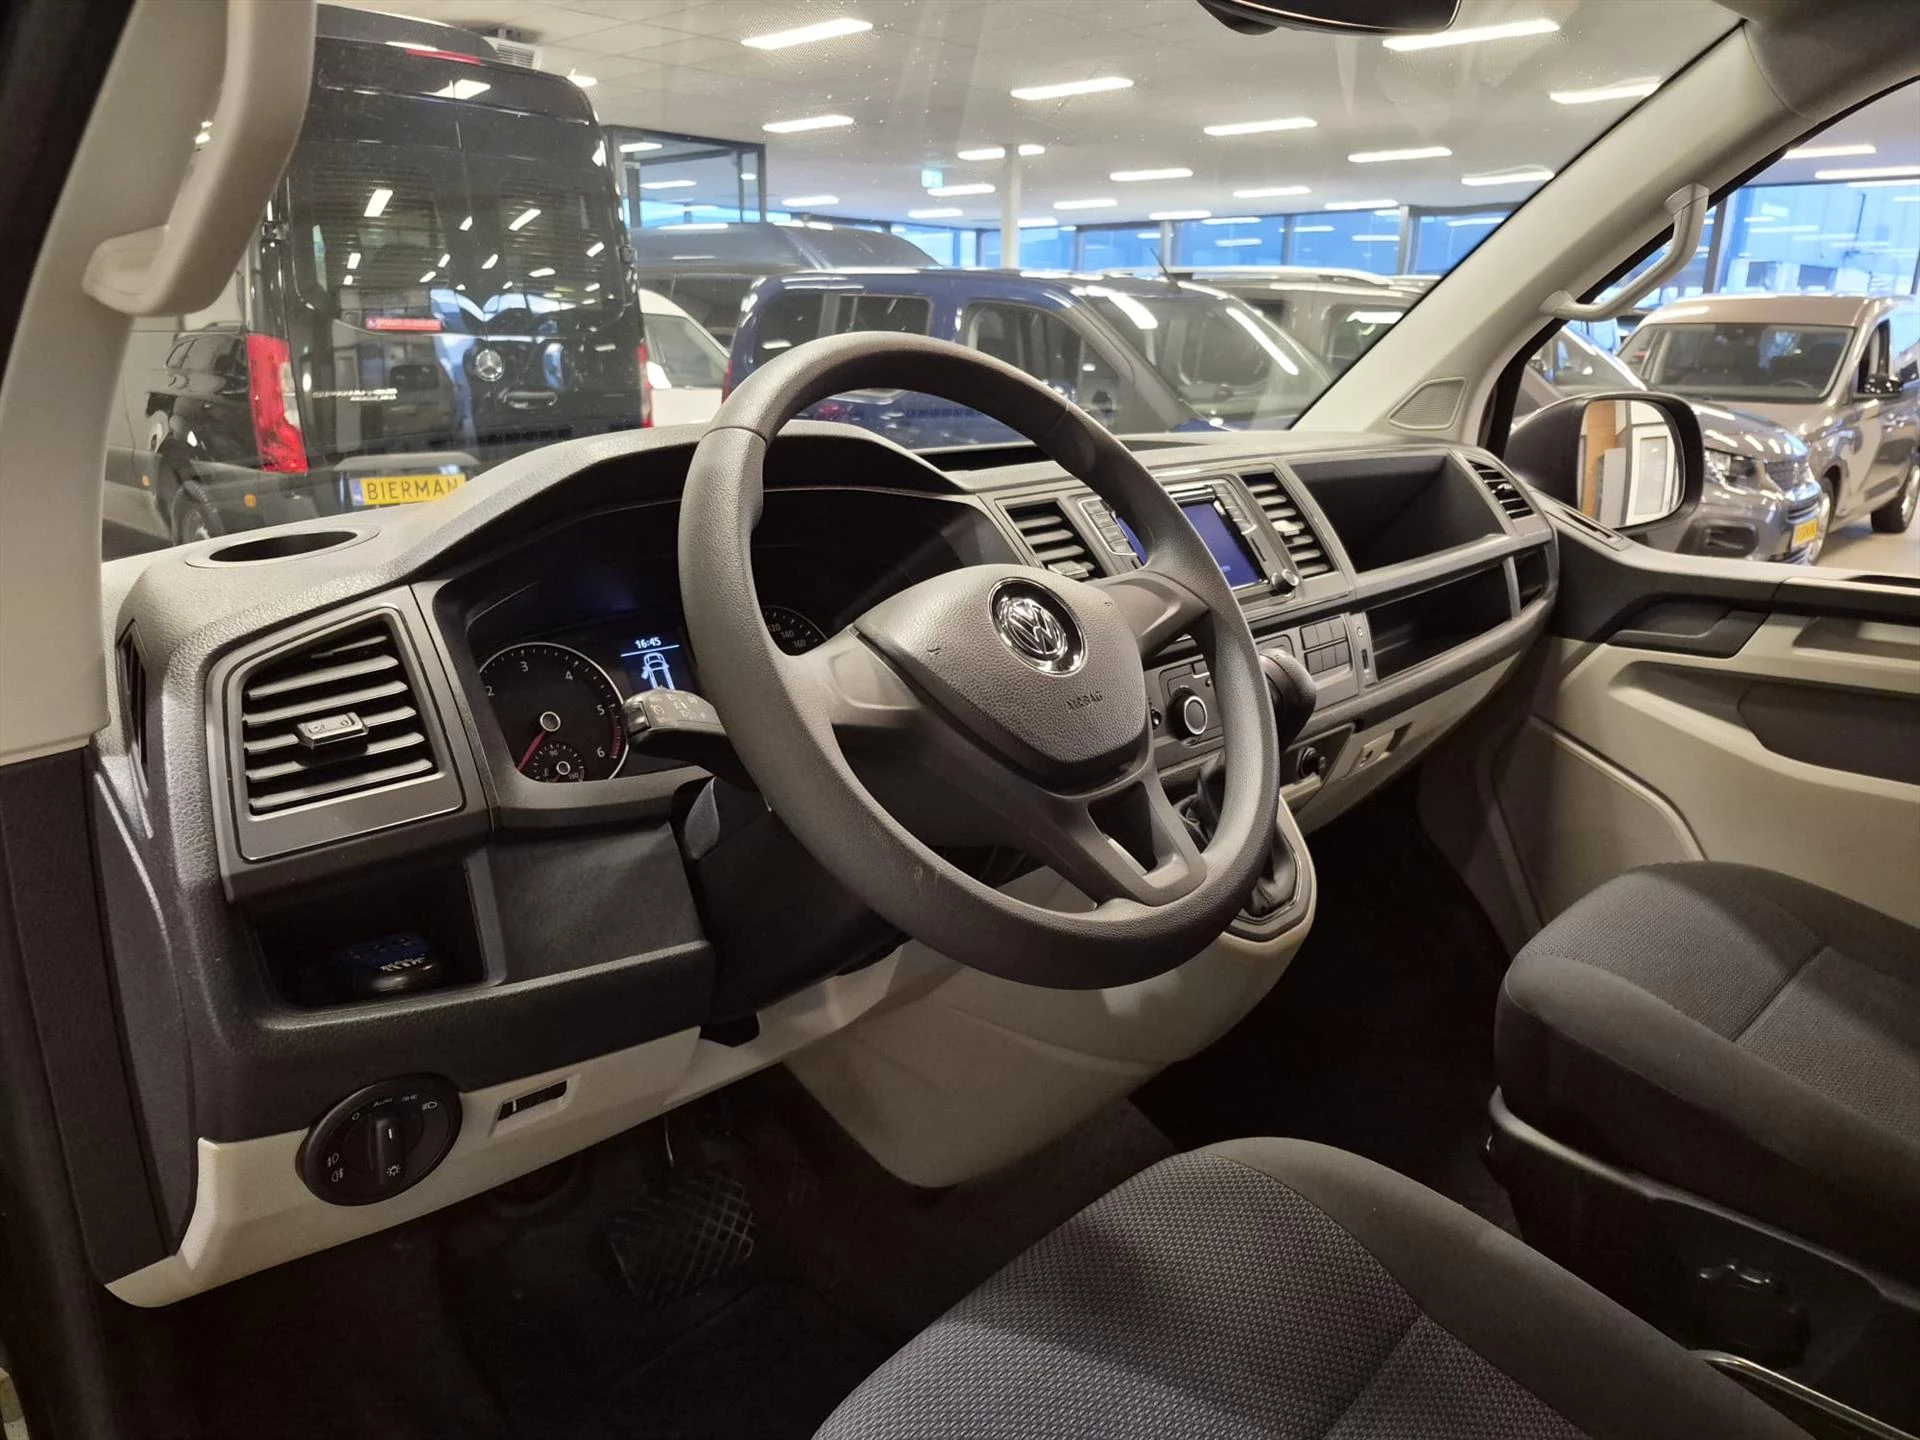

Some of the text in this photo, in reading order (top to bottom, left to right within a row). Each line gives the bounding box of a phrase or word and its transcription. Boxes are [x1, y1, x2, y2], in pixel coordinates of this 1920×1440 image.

[367, 478, 458, 500] BIERMAN
[634, 637, 662, 650] 16:45
[520, 660, 529, 673] 3
[565, 670, 574, 681] 4
[486, 685, 495, 697] 2
[597, 704, 605, 716] 5
[597, 746, 605, 758] 6
